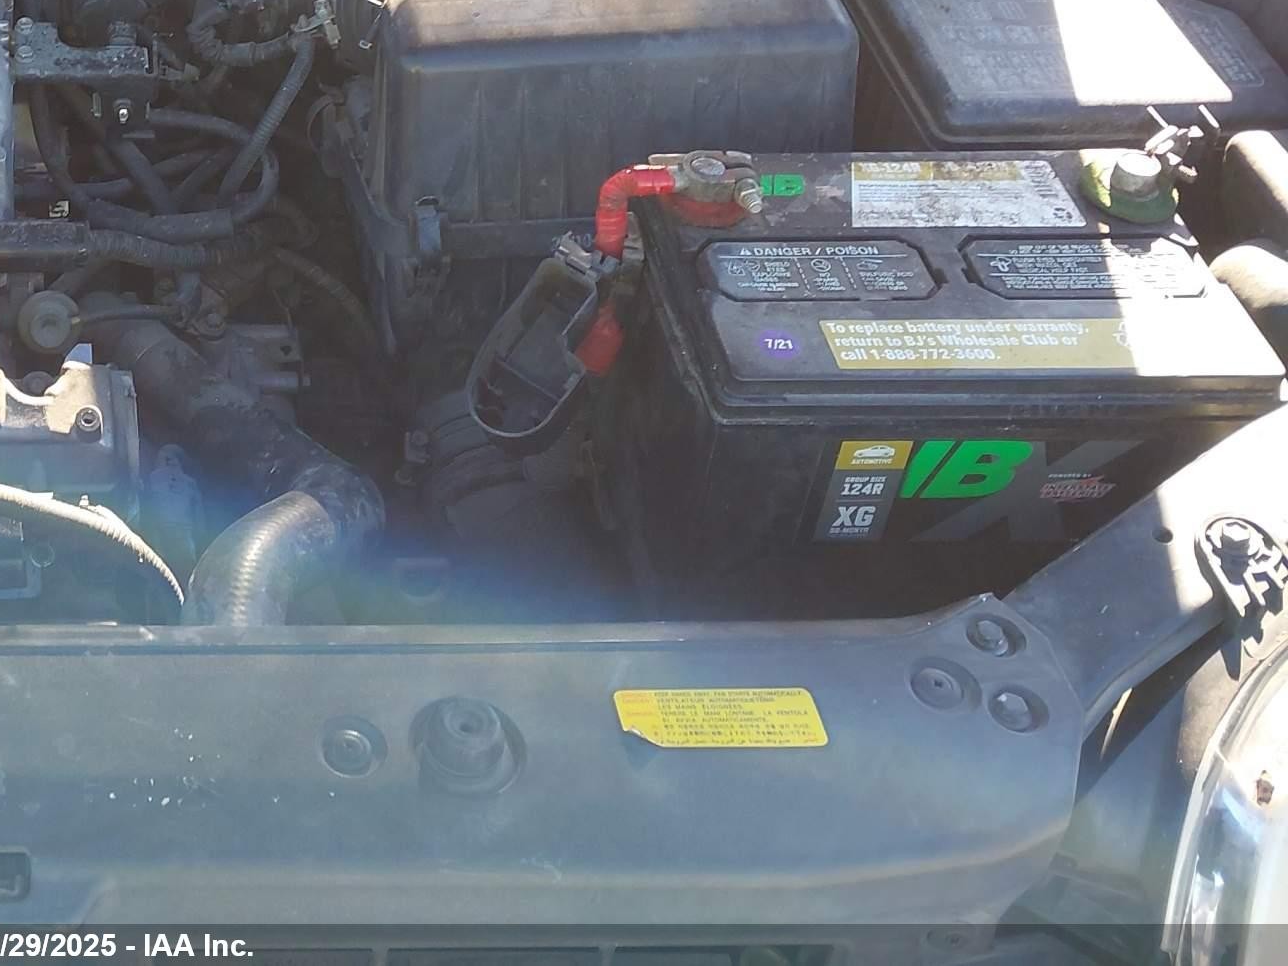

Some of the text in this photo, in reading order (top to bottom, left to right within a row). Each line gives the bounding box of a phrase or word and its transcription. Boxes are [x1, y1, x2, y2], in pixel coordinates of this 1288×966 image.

[753, 245, 879, 256] DANGER / POISON
[826, 321, 1090, 336] To replace battery under warranty,
[764, 338, 794, 350] 7/21
[834, 336, 882, 347] return
[885, 336, 902, 347] to
[936, 335, 1020, 347] Wholesale
[1021, 335, 1059, 347] Club
[1061, 337, 1079, 347] or
[840, 349, 1002, 361] call 1-888-772-3600.
[840, 483, 885, 496] 124R
[832, 506, 877, 527] XG
